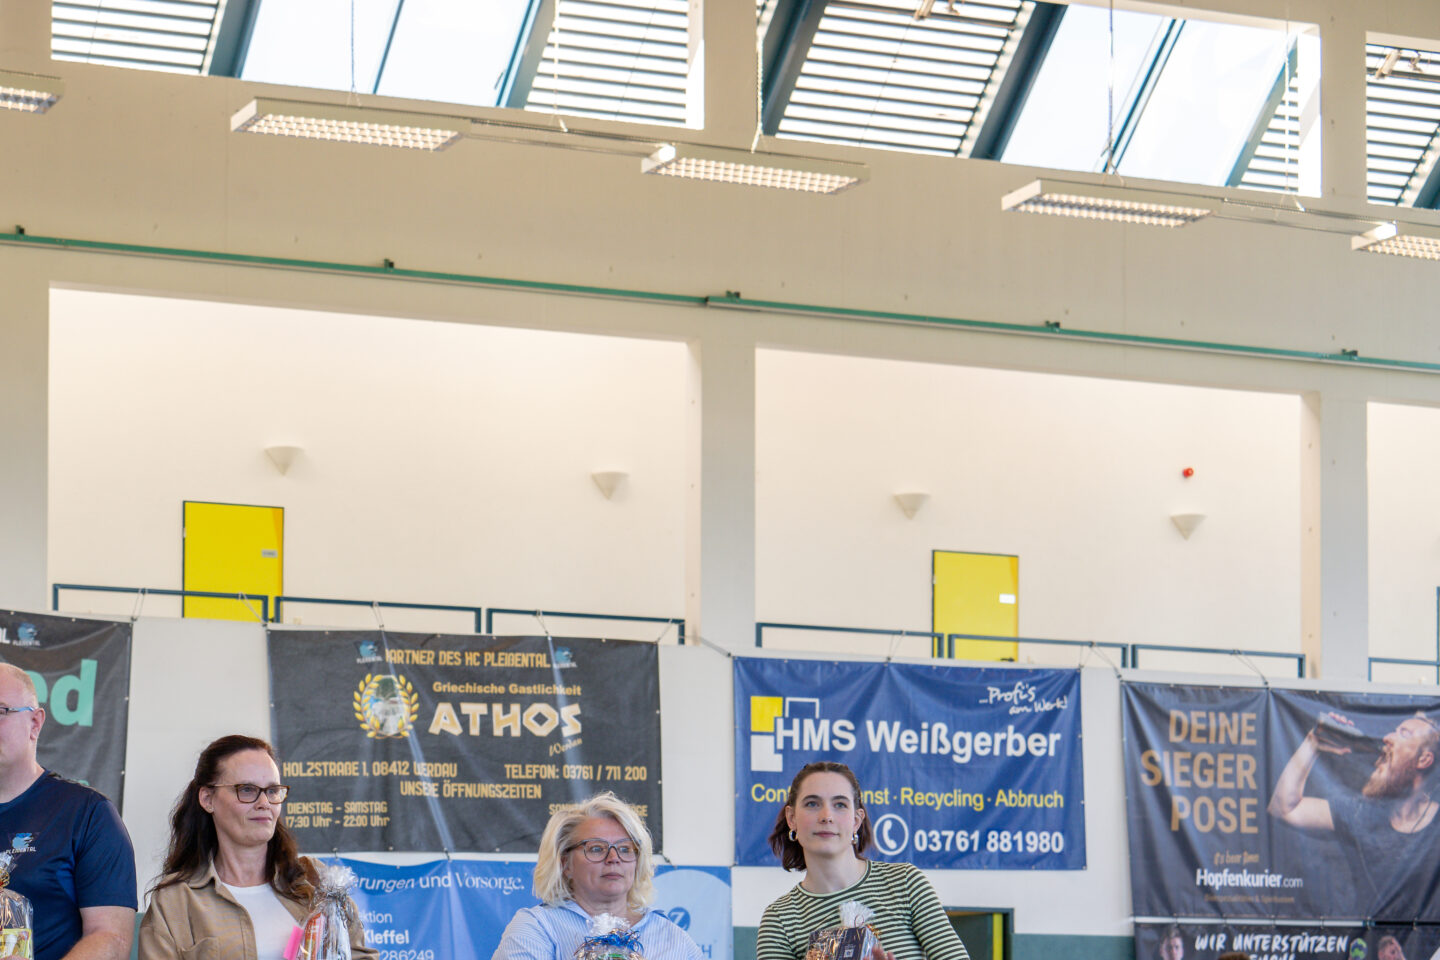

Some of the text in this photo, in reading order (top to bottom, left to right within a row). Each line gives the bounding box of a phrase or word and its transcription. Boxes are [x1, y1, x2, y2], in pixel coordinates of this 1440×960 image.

[439, 650, 461, 666] DES
[465, 652, 481, 667] HC
[432, 681, 582, 696] Griechische Gastlichkeit
[428, 702, 582, 737] ATHOS
[1169, 709, 1257, 746] DEINE
[776, 717, 1061, 764] HMS Weißgerber
[372, 761, 409, 776] 08412
[504, 764, 559, 779] TELEFON:
[562, 764, 593, 780] 03761
[605, 766, 621, 781] 711
[624, 766, 647, 781] 200
[1140, 750, 1257, 790] SIEGER
[442, 779, 542, 799] ÖFFNUNGSZEITEN
[901, 787, 984, 811] Recycling
[995, 789, 1064, 809] Abbruch
[286, 801, 333, 814] DIENSTAG
[344, 801, 388, 814] SAMSTAG
[1171, 796, 1259, 834] POSE
[312, 816, 332, 828] Uhr
[343, 815, 368, 827] 22:00
[370, 816, 390, 827] Uhr
[914, 829, 1064, 854] 03761 881980
[419, 872, 451, 888] und
[457, 872, 525, 895] Vorsorge.
[1196, 868, 1303, 890] Hopfenkurier.com
[1195, 932, 1349, 953] WIR UNTERSTÜTZEN
